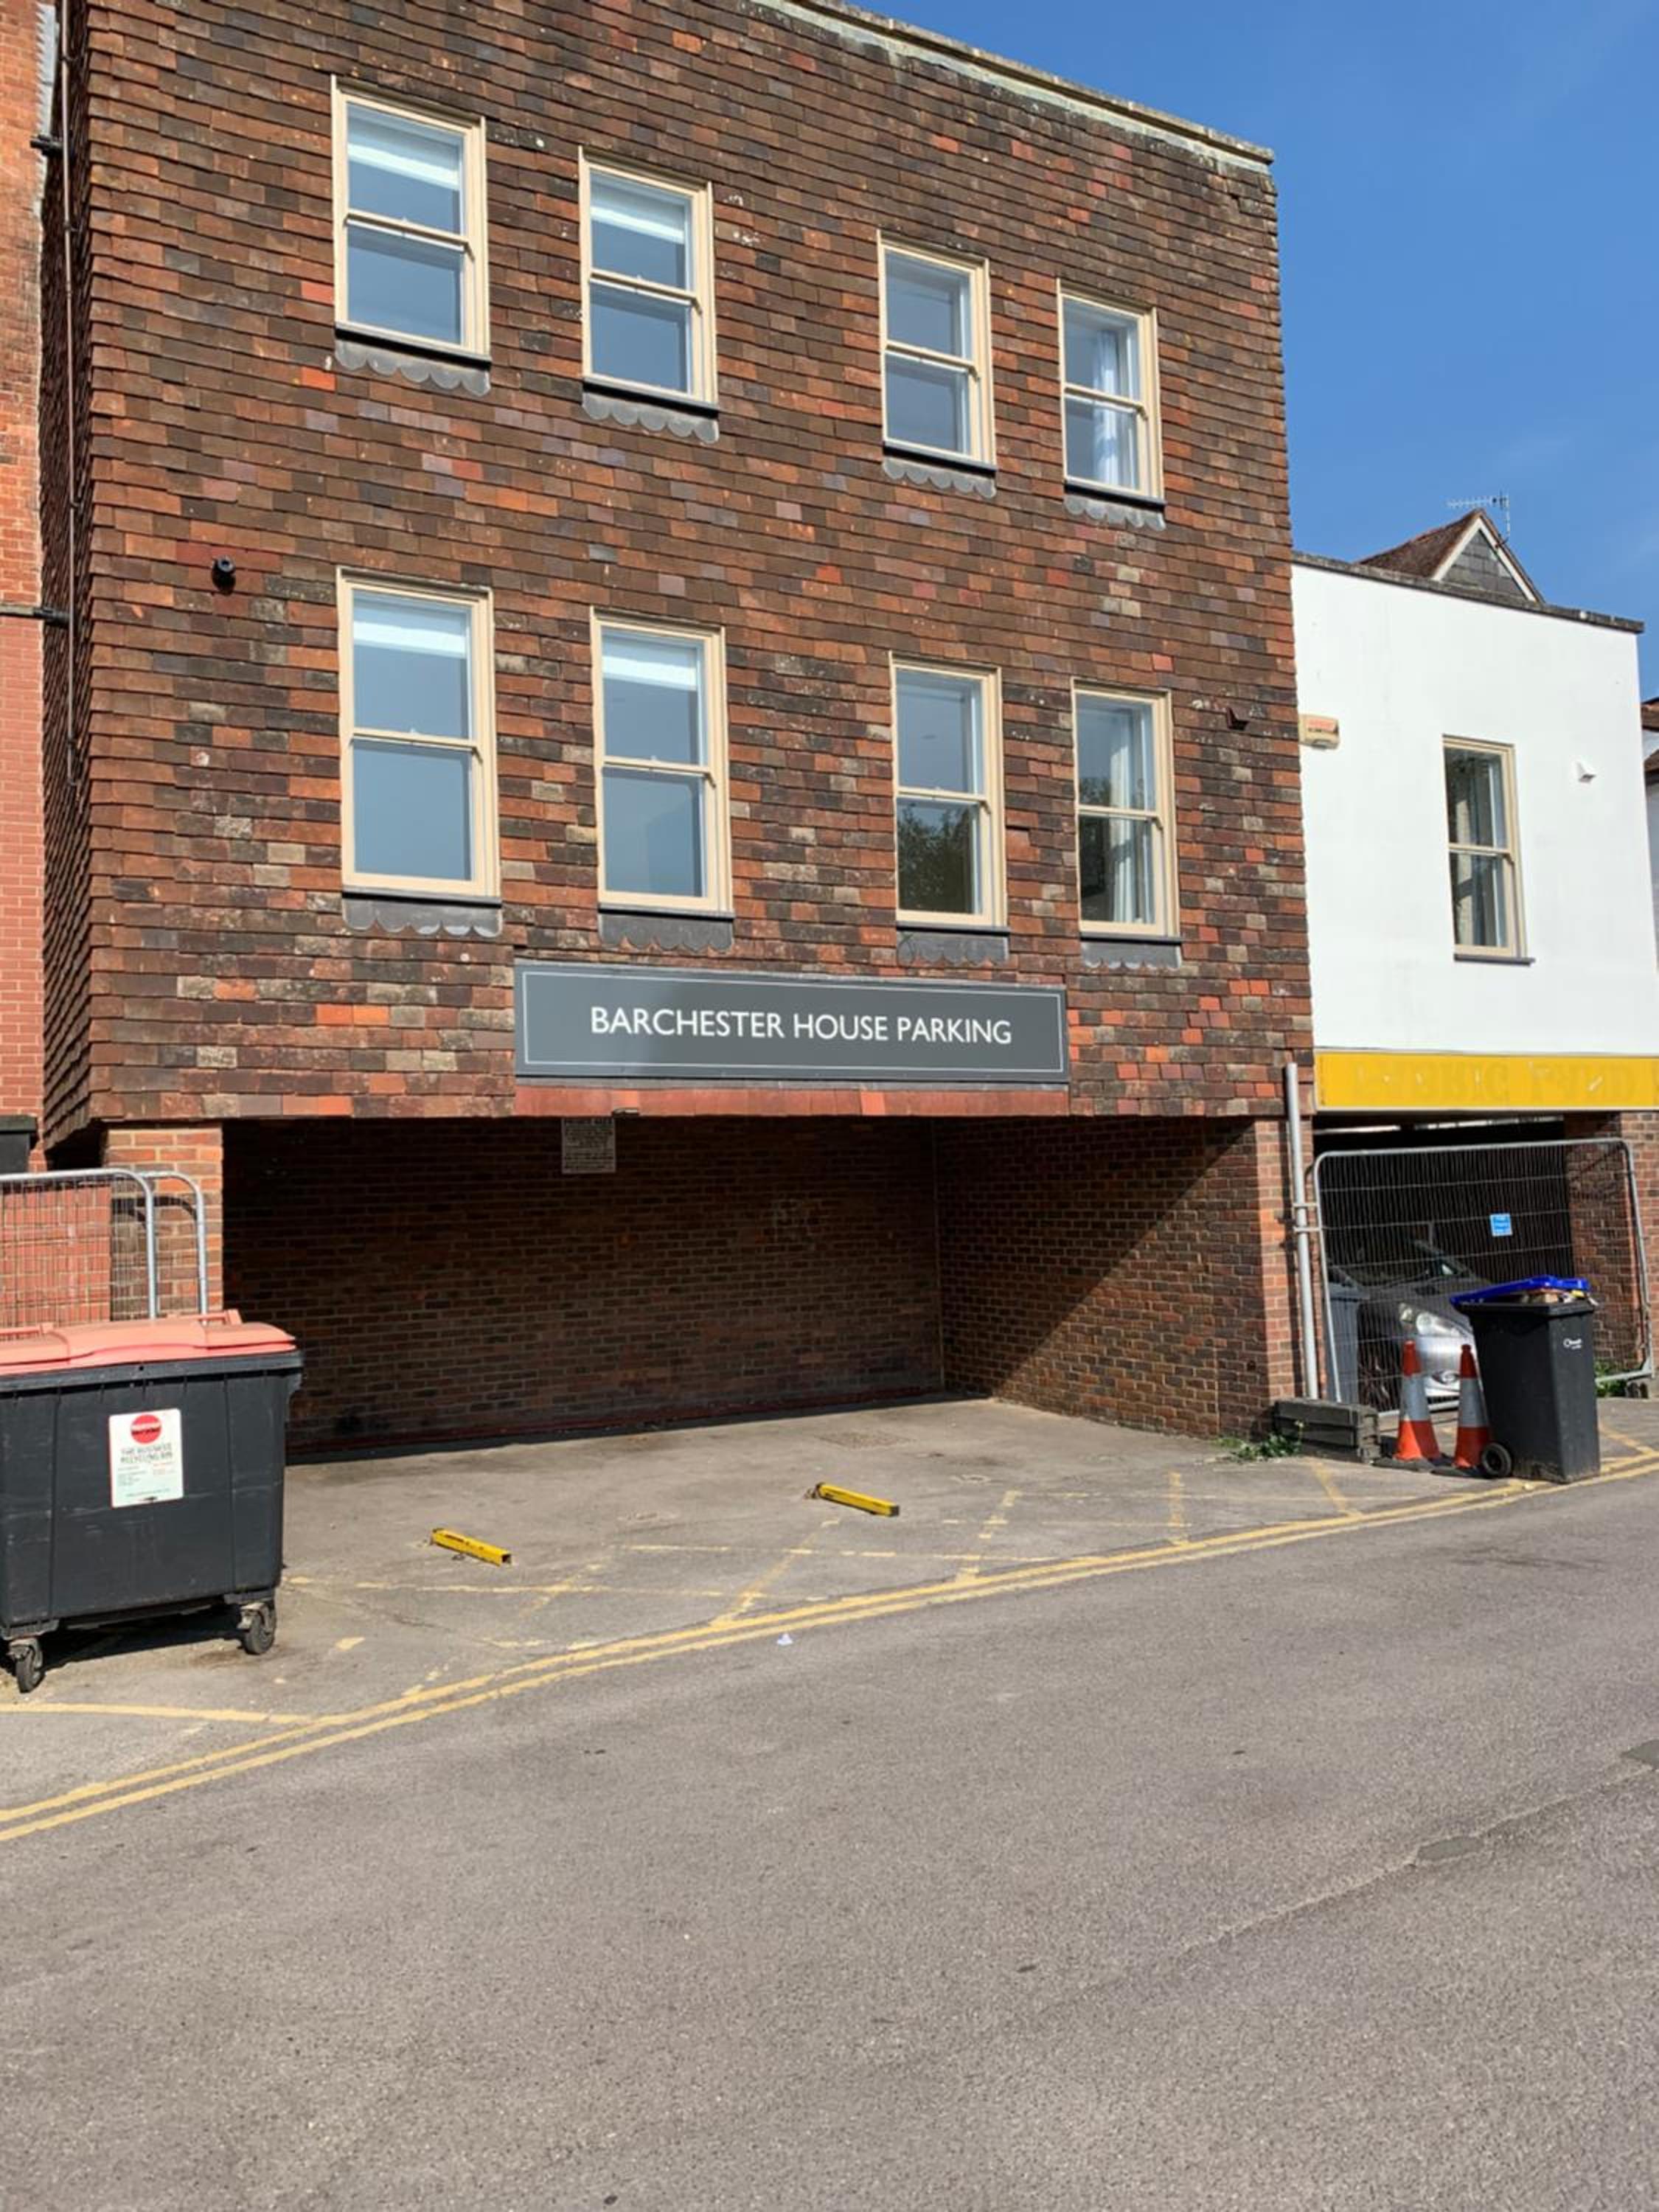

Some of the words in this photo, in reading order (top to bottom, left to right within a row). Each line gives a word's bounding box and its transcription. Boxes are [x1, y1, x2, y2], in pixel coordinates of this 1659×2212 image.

[591, 1006, 785, 1038] BARCHESTER
[793, 1013, 888, 1040] HOUSE
[897, 1016, 1012, 1045] PARKING
